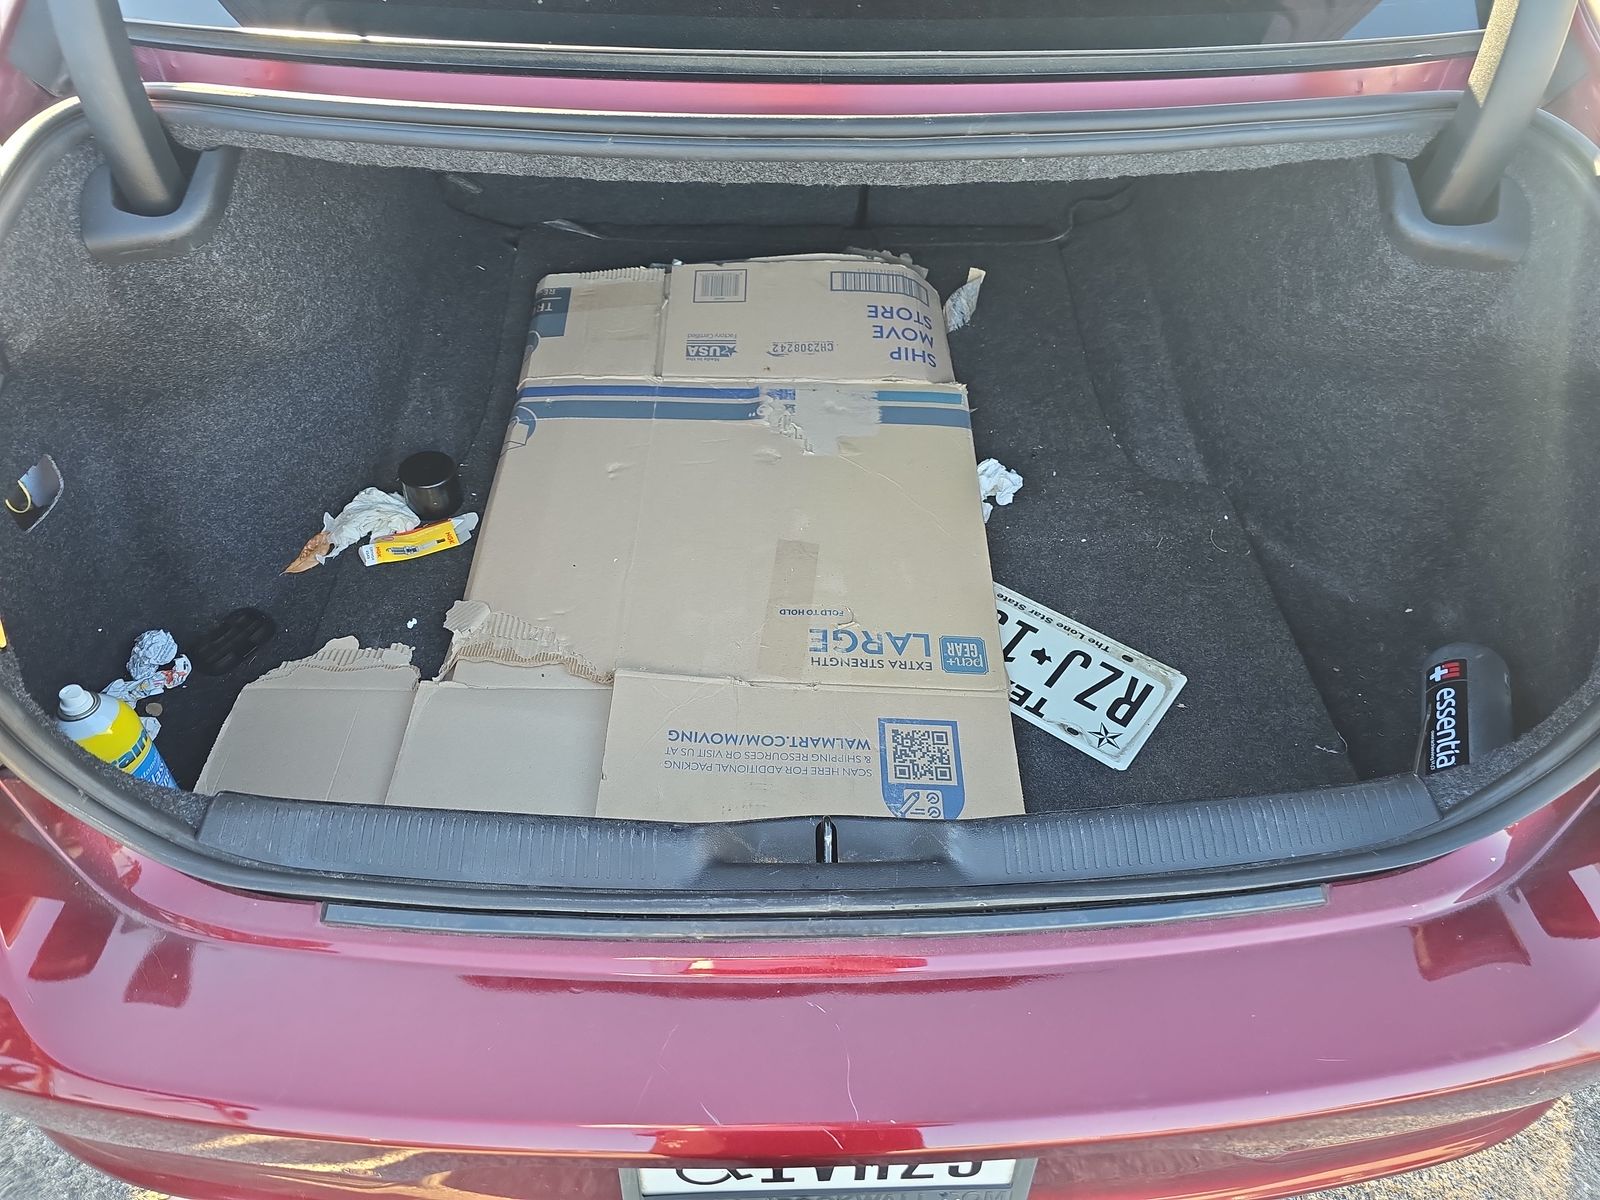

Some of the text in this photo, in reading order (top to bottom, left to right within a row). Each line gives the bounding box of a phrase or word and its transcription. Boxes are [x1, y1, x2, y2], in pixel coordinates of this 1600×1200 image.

[532, 302, 553, 312] TR
[867, 305, 932, 329] STORE
[872, 325, 934, 349] MOVE
[687, 345, 720, 355] USA
[772, 342, 834, 353] CH2308242
[890, 346, 937, 368] SHIP
[779, 608, 804, 616] HOLD
[820, 609, 844, 617] FOLD
[996, 593, 1110, 653] The Lone Star State
[809, 629, 931, 657] LARGE
[946, 642, 978, 658] GEAR
[810, 657, 933, 671] EXTRA STRENGTH
[1009, 680, 1048, 719] TE
[1435, 687, 1460, 770] essentia
[111, 729, 149, 769] ain
[668, 730, 871, 750] WALMART.COM/MOVING
[665, 747, 872, 764] & SHIPPING RESOURCES OR VISIT US AT
[664, 760, 873, 778] SCAN HERE FOR ADDITIONAL PACKING
